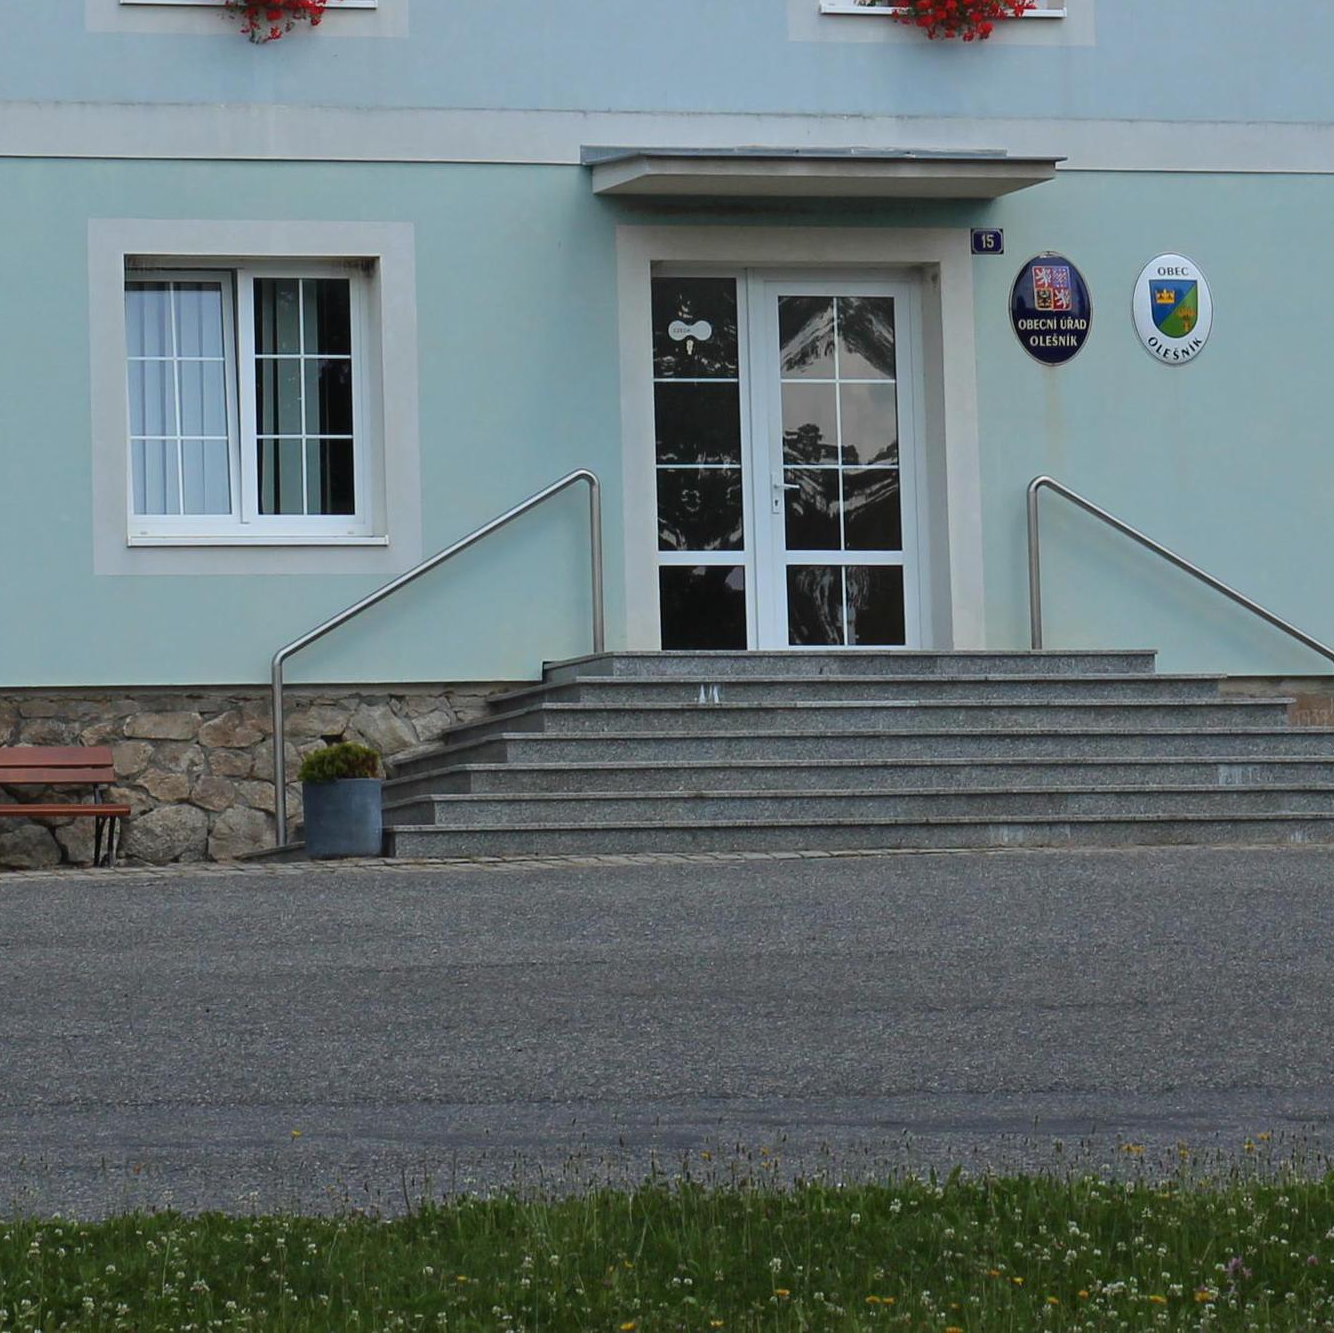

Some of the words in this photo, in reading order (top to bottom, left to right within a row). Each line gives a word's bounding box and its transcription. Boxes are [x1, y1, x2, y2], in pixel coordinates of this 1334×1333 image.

[981, 234, 995, 249] 15
[1157, 266, 1189, 276] OBEC
[1018, 316, 1057, 330] OBECNÍ
[1060, 316, 1087, 330] ÚŘAD
[1029, 333, 1078, 347] OLEŠNÍK
[1148, 336, 1203, 361] OLEŠNÍK
